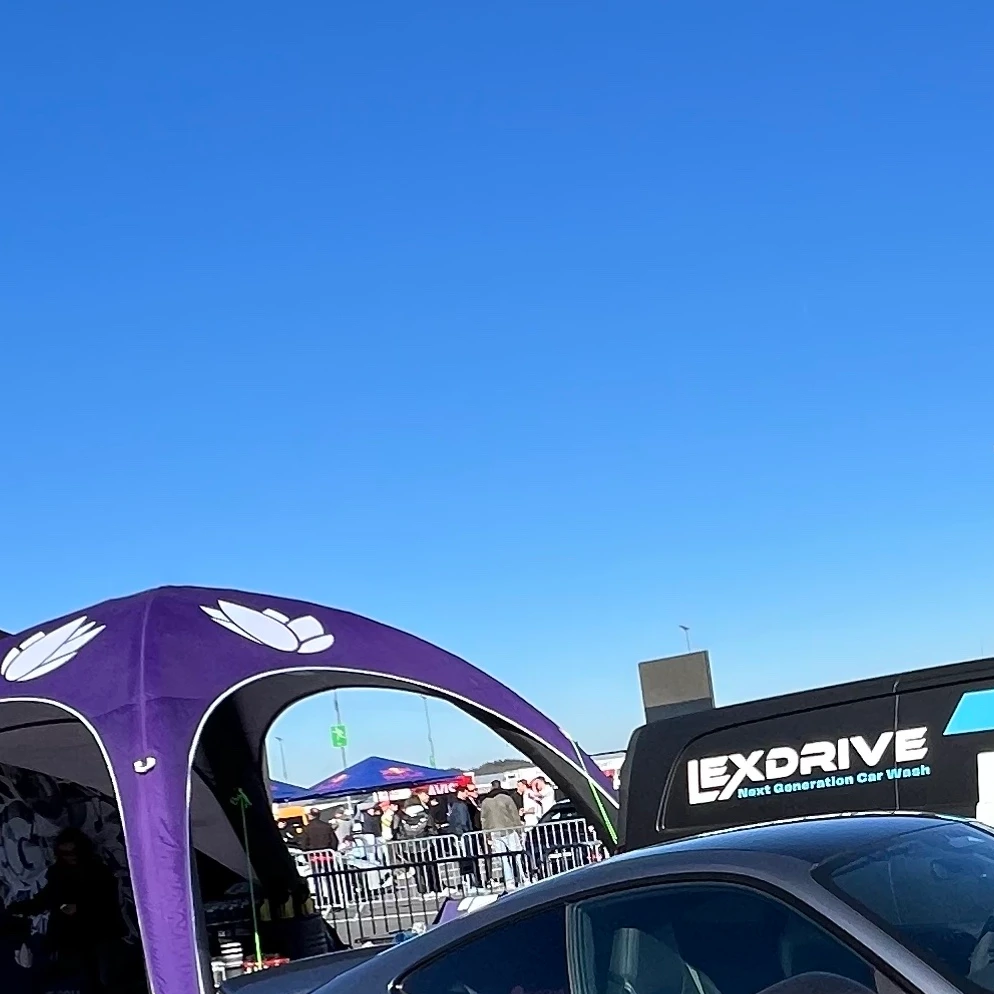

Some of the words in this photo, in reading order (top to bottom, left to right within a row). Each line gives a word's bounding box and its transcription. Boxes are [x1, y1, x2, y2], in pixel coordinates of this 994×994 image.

[687, 726, 929, 805] LEXDRIVE
[737, 783, 771, 799] Next
[773, 775, 854, 795] Generation
[856, 770, 884, 784] Car
[886, 764, 931, 780] Wash
